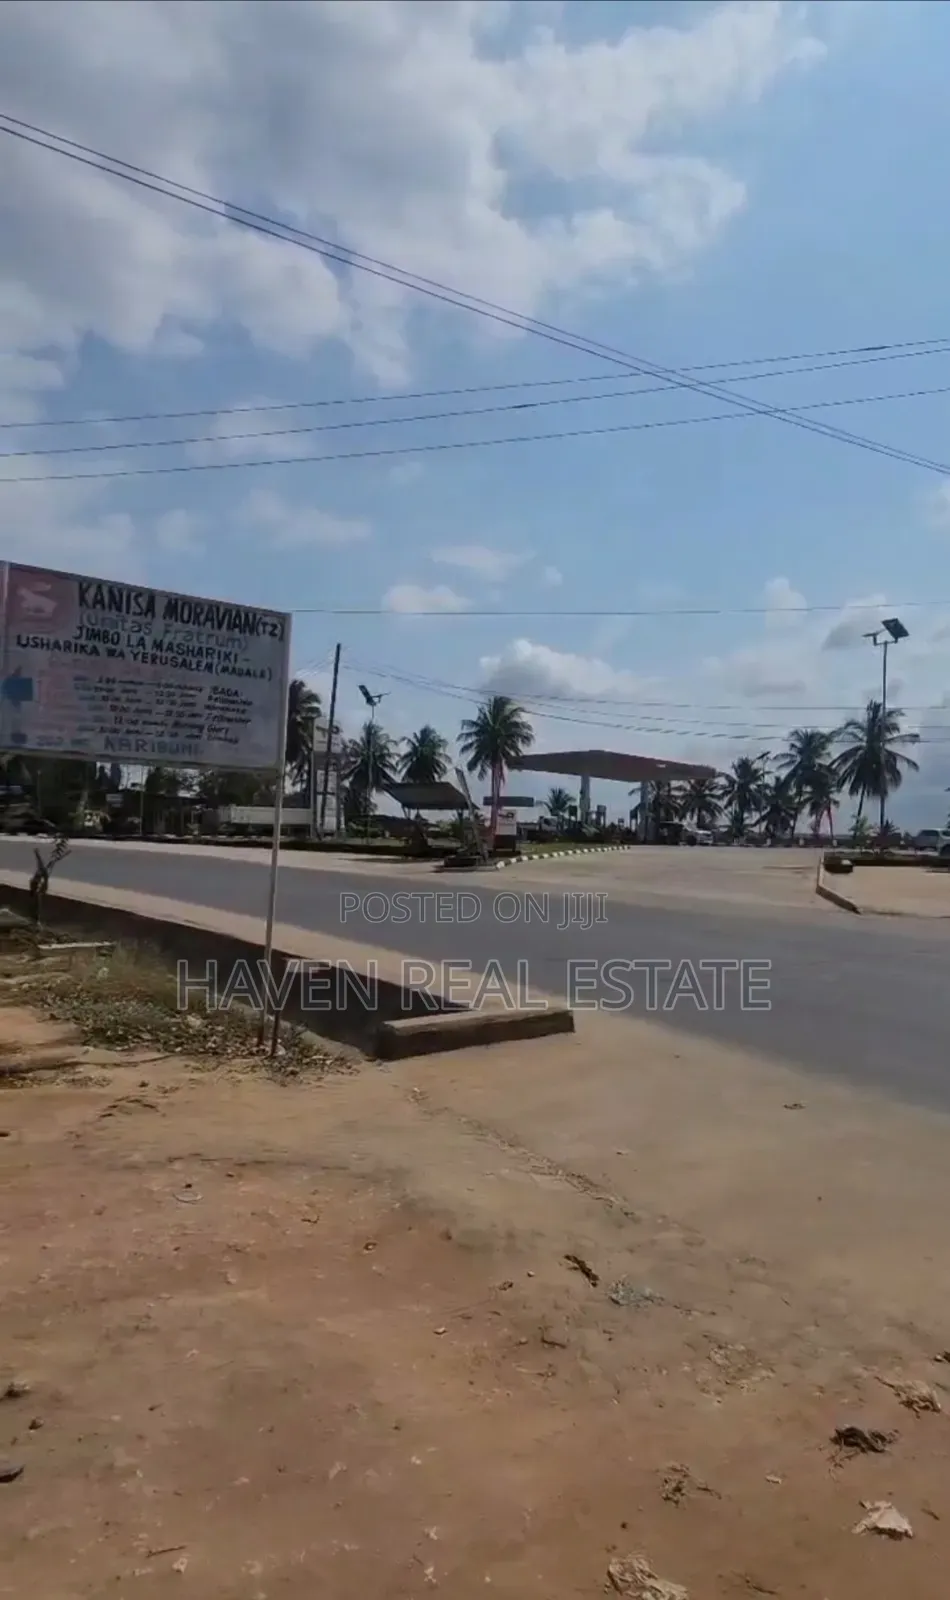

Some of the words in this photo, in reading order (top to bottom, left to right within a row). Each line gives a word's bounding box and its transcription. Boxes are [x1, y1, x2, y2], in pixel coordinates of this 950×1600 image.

[79, 581, 156, 620] KANISA
[16, 634, 100, 657] USHARIKA
[106, 647, 125, 661] WA
[73, 625, 121, 646] JIMBO
[127, 633, 146, 650] LA
[151, 639, 239, 664] MASHARIKI
